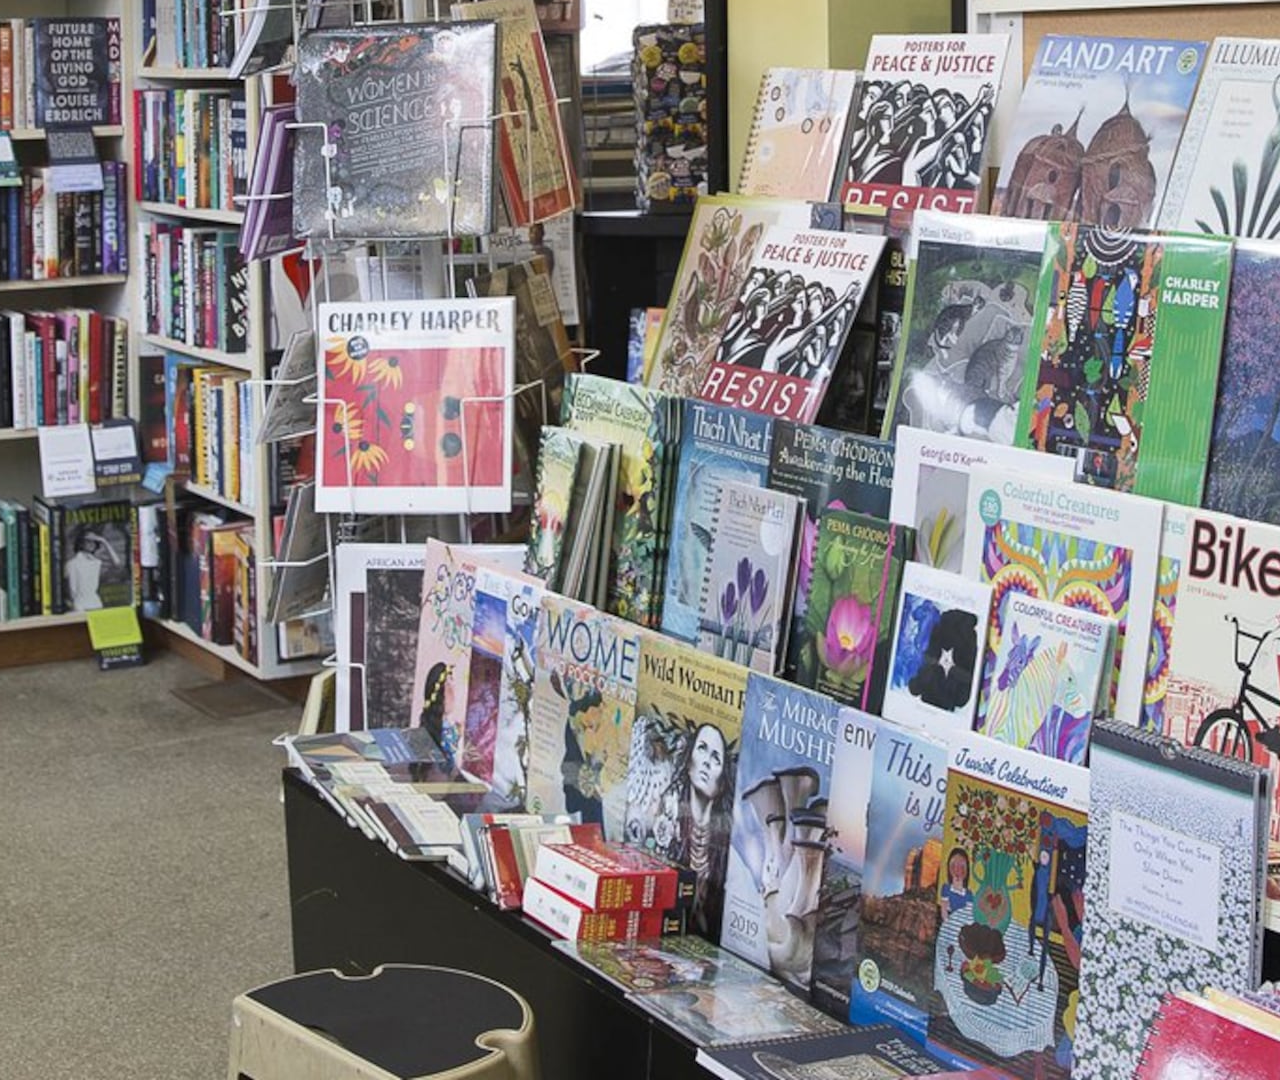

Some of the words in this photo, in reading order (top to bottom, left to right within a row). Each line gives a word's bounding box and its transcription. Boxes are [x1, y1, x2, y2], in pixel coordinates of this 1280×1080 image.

[48, 23, 95, 36] FUTURE
[52, 36, 91, 48] HOME
[904, 41, 941, 53] POSTERS
[943, 41, 966, 52] FOR
[51, 48, 69, 60] OF
[71, 48, 94, 60] THE
[1040, 41, 1120, 73] LAND
[1122, 44, 1174, 76] ART
[49, 61, 94, 74] LIVING
[872, 55, 918, 73] PEACE
[920, 57, 932, 73] &
[935, 55, 997, 75] JUSTICE
[58, 74, 88, 87] GOD
[347, 71, 420, 103] WOMEN
[49, 94, 98, 108] LOUISE
[45, 108, 102, 122] ERDRICH
[348, 95, 437, 134] SCIENCE
[793, 234, 828, 247] POSTERS
[828, 237, 847, 249] FOR
[761, 244, 802, 263] PEACE
[803, 251, 814, 265] &
[815, 249, 870, 271] JUSTICE
[1165, 276, 1221, 293] CHARLEY
[1162, 290, 1221, 309] HARPER
[328, 312, 411, 334] CHARLEY
[420, 310, 502, 333] HARPER
[701, 366, 821, 417] RESIST
[692, 405, 725, 441] Thich
[728, 414, 761, 453] Nhat
[794, 428, 828, 454] PEMA
[920, 444, 952, 464] Georgia
[778, 447, 842, 483] Awakening
[846, 463, 867, 481] the
[1003, 481, 1054, 508] Colorful
[1056, 493, 1121, 521] Creatures
[827, 520, 852, 534] PEMA
[366, 559, 406, 568] AFRICAN
[1013, 601, 1054, 622] COLORFUL
[1055, 614, 1103, 636] CREATURES
[643, 652, 678, 686] Wild
[678, 665, 739, 704] Woman
[884, 738, 932, 788] This
[954, 747, 995, 778] Jewish
[996, 758, 1070, 800] Celebrations
[1178, 841, 1194, 853] Can
[729, 912, 759, 936] 2019
